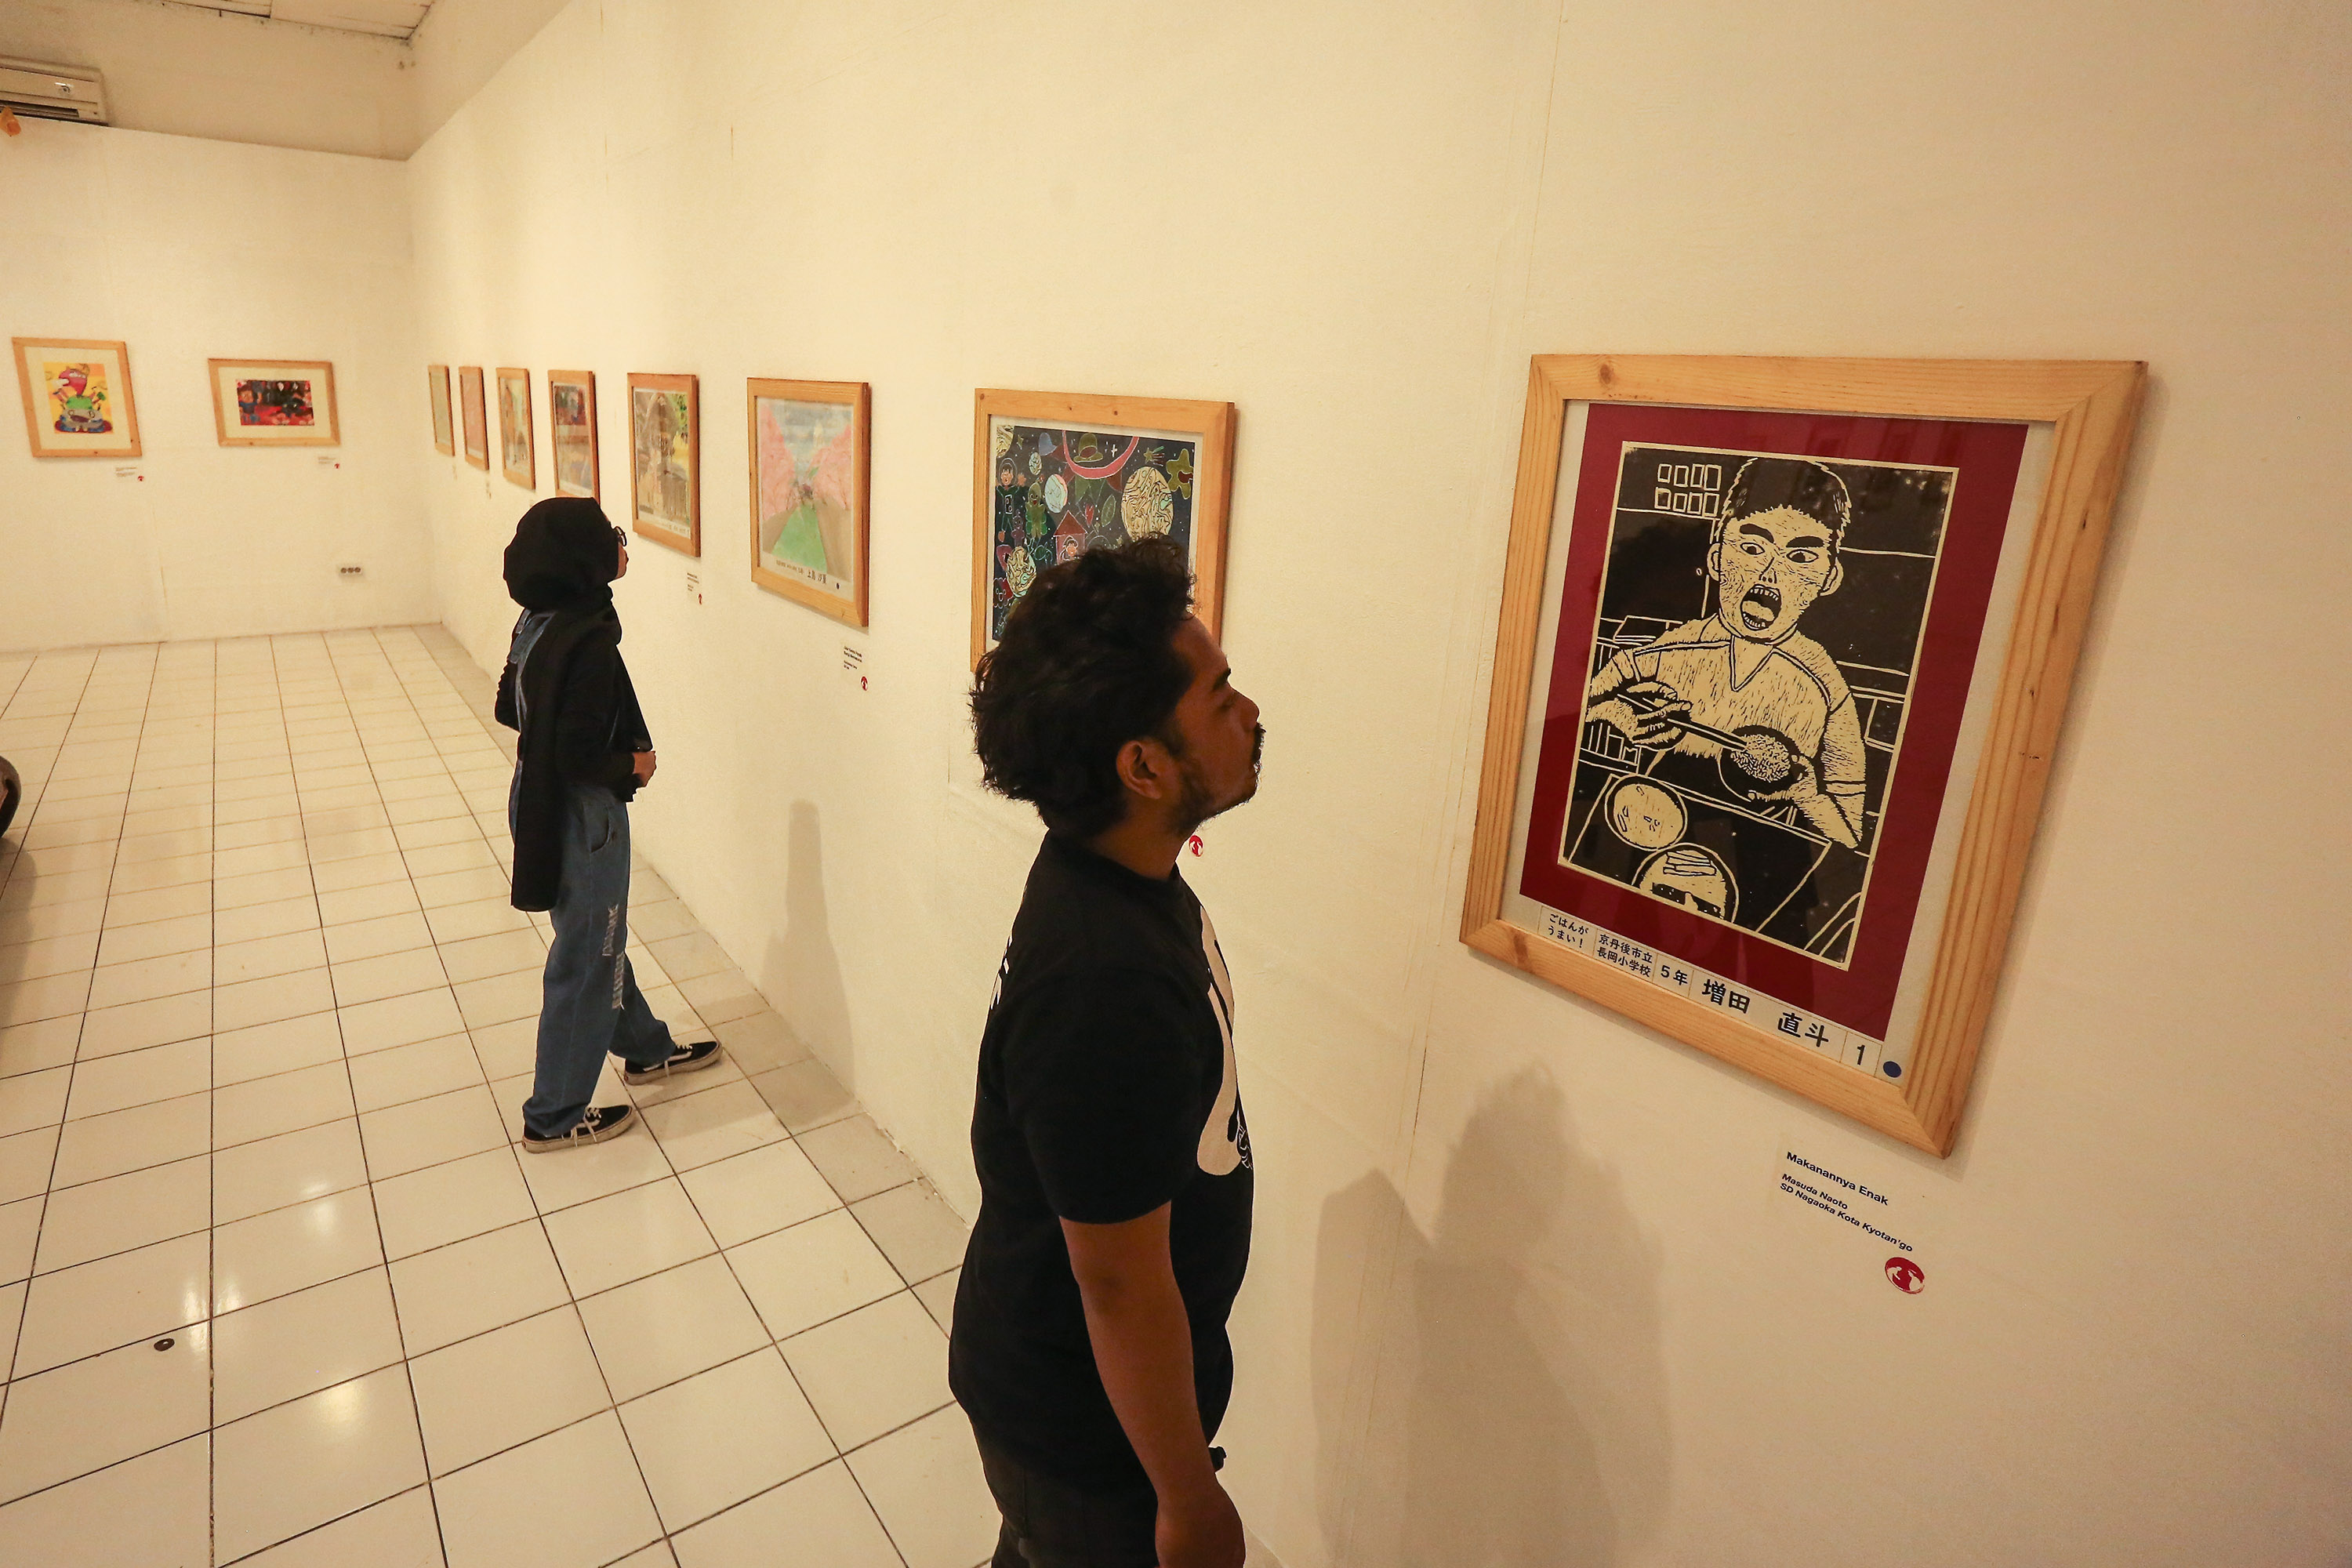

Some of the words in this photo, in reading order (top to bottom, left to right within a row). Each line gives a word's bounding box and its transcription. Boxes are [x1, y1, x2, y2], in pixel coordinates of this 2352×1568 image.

[1549, 913, 1589, 935] ごはんが
[1597, 946, 1651, 978] 長岡小学校
[1599, 934, 1653, 964] 京丹後市立
[1661, 965, 1688, 985] 5年
[1701, 978, 1751, 1014] 増田
[1777, 1012, 1829, 1047] 直斗
[1857, 1044, 1865, 1065] 1
[1782, 1174, 1817, 1195] Masuda
[1820, 1192, 1848, 1210] Naoto
[1787, 1152, 1856, 1190] Makanannya
[1859, 1185, 1888, 1205] Enak
[1780, 1183, 1794, 1193] SD
[1795, 1190, 1835, 1214] Nagaoka
[1838, 1211, 1860, 1226] Kota
[1862, 1223, 1913, 1252] Kyotan'go
